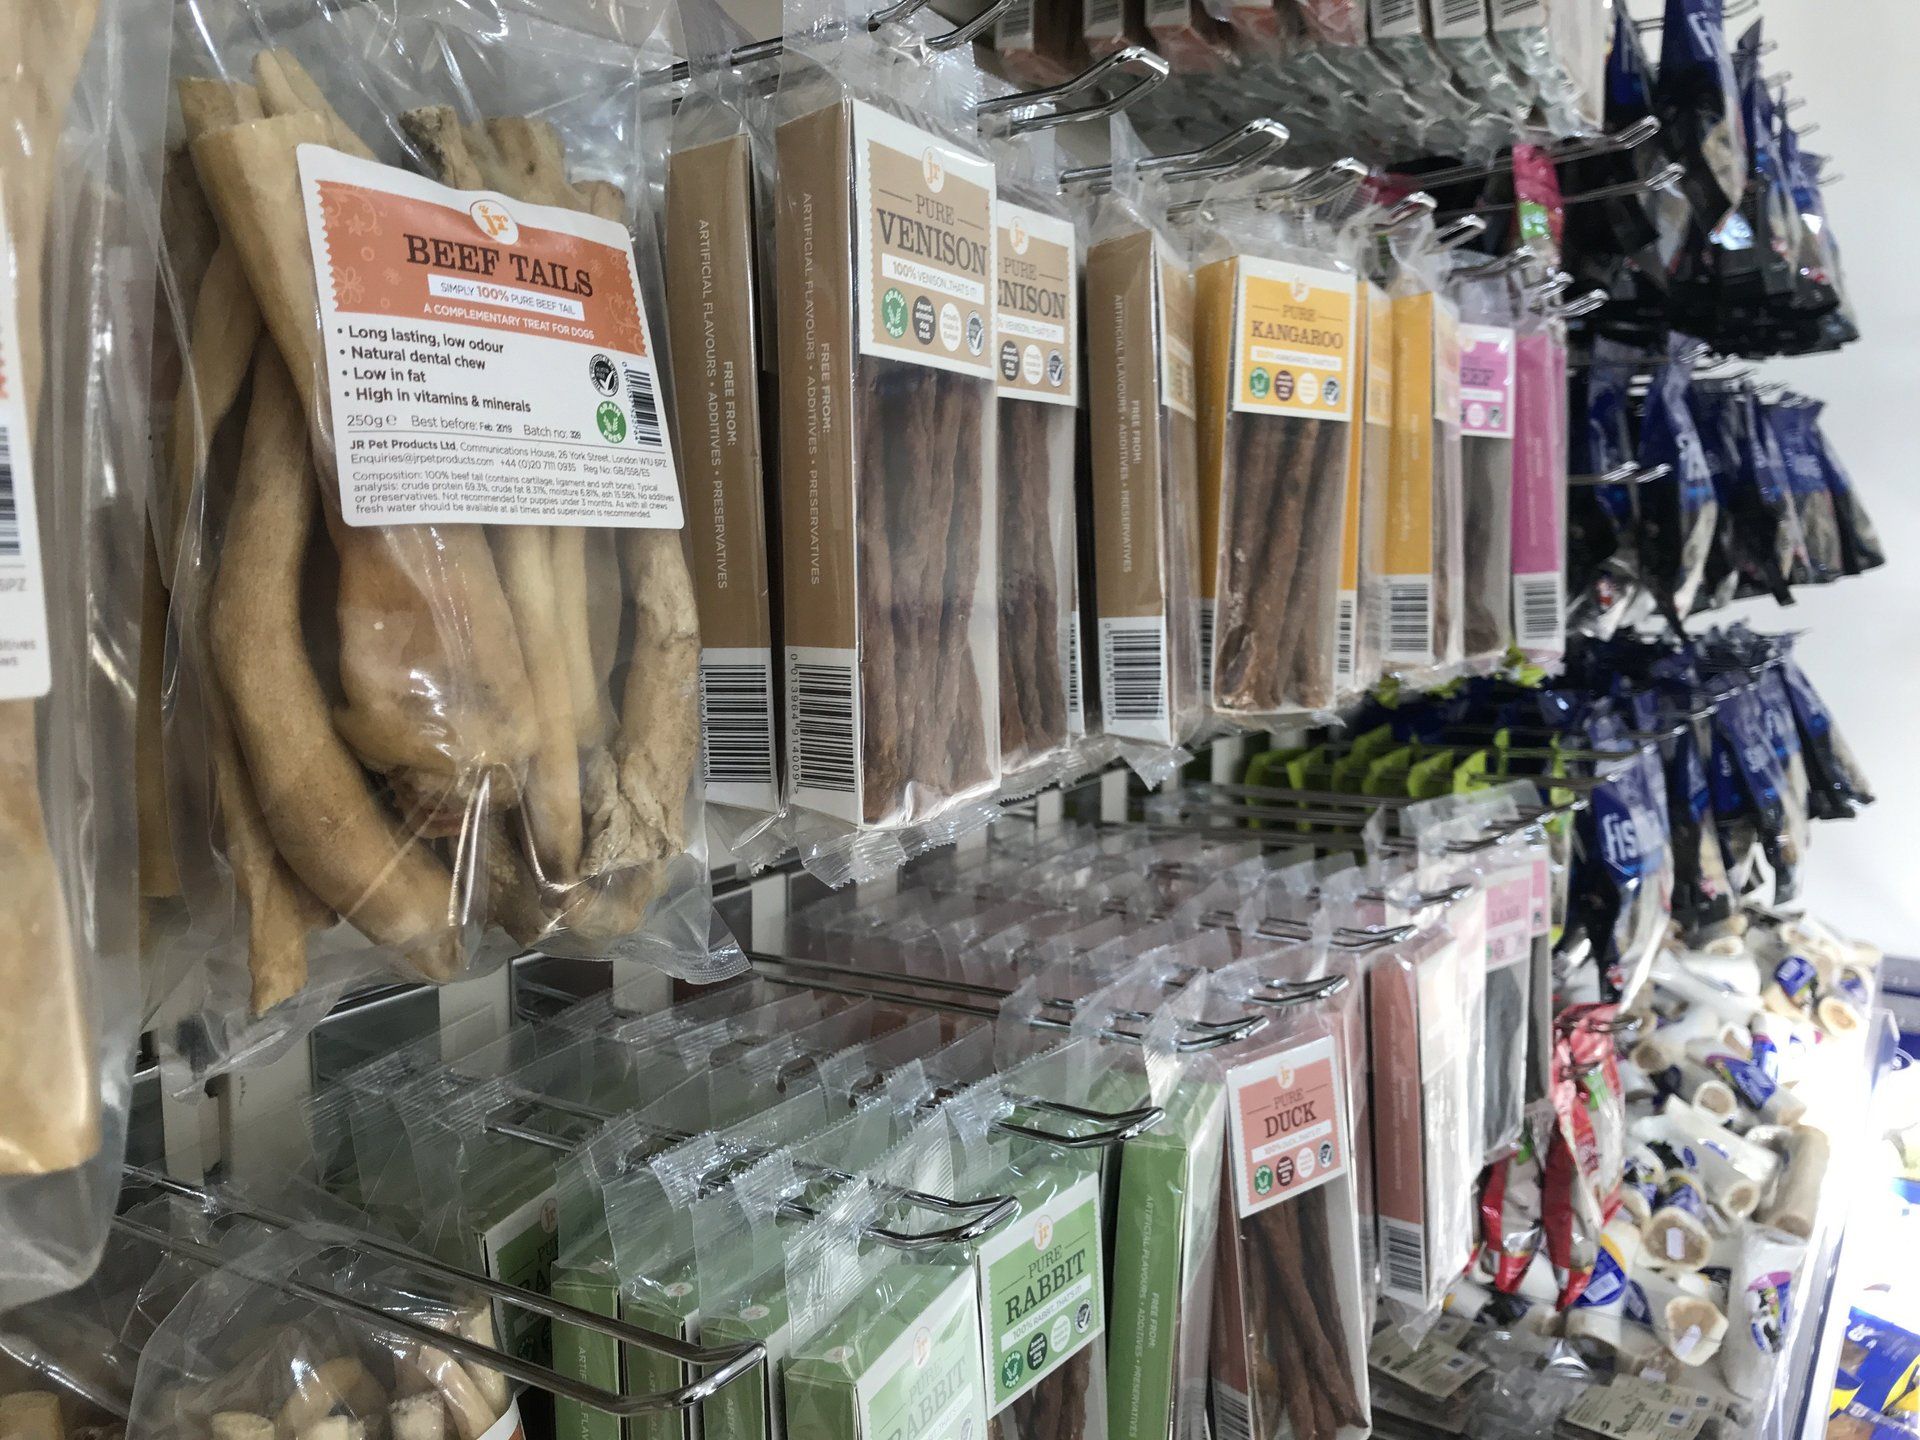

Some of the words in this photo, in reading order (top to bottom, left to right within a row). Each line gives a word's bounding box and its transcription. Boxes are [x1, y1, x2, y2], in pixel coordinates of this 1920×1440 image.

[916, 193, 954, 226] PURE
[802, 192, 813, 277] ARTIFICIAL
[877, 209, 987, 276] VENISON
[403, 233, 499, 276] BEEF
[509, 253, 593, 297] TAILS
[699, 219, 713, 299] ARTIFICIAL
[1004, 256, 1036, 280] PURE
[440, 282, 474, 296] SIMPLY
[476, 285, 509, 302] 100%
[511, 293, 534, 307] PURE
[536, 298, 557, 311] BEEF
[557, 303, 576, 315] TAIL
[998, 279, 1066, 319] NISON
[424, 303, 432, 314] A
[434, 304, 519, 326] COMPLEMENTARY
[522, 318, 550, 331] TREAT
[552, 323, 570, 334] FOR
[572, 326, 595, 340] DOGS
[804, 280, 815, 360] FLAVOURS
[1251, 320, 1343, 348] KANGAROO
[349, 325, 387, 342] Long
[392, 328, 440, 347] lasting,
[444, 333, 465, 347] low
[469, 339, 503, 353] odour
[351, 346, 405, 361] Natural
[410, 350, 450, 365] dental
[455, 356, 485, 369] chew
[703, 302, 717, 378] FLAVOURS
[354, 367, 386, 380] Low
[391, 368, 403, 381] in
[408, 369, 426, 383] fat
[723, 360, 734, 397] FREE
[820, 342, 830, 382] FREE
[356, 387, 393, 403] High
[397, 388, 410, 401] in
[414, 390, 468, 406] vitamins
[471, 395, 479, 407] &
[483, 397, 531, 412] minerals
[1116, 356, 1127, 413] FLAVOURS
[347, 415, 383, 427] 250g
[411, 415, 437, 428] Best
[440, 416, 477, 431] before:
[523, 425, 550, 437] Batch
[725, 401, 737, 446] FROM:
[806, 376, 817, 456] ADDITIVES
[821, 386, 831, 433] FROM:
[1130, 400, 1140, 427] FREE
[707, 391, 721, 467] ADDITIVES
[350, 440, 364, 450] JR
[369, 440, 387, 449] Pet
[392, 440, 437, 450] Products
[460, 443, 529, 456] Communications
[530, 449, 557, 460] House,
[559, 450, 568, 459] 26
[570, 450, 585, 461] York
[612, 455, 638, 465] London
[351, 454, 494, 466] Enquiries@jrpetproducts.com
[500, 459, 516, 468] +44
[518, 460, 541, 470] (0)20
[583, 465, 598, 475] Reg
[1118, 423, 1129, 481] ADDITIVES
[352, 471, 422, 482] Composition:
[425, 470, 449, 480] 100%
[451, 471, 469, 480] beef
[472, 471, 483, 480] tail
[485, 472, 519, 483] (contains
[556, 478, 585, 488] ligament
[354, 482, 398, 492] analysis:
[402, 482, 429, 490] crude
[432, 483, 463, 492] protein
[490, 484, 512, 493] crude
[549, 488, 579, 496] moisture
[355, 494, 366, 502] or
[370, 492, 438, 503] preservatives.
[460, 492, 514, 503] recommended
[517, 495, 528, 503] for
[530, 496, 558, 506] puppies
[560, 498, 580, 506] under
[356, 503, 383, 514] fresh
[387, 503, 416, 512] water
[419, 502, 450, 511] should
[453, 502, 463, 511] be
[466, 502, 498, 512] available
[500, 504, 508, 513] at
[520, 506, 540, 514] times
[542, 506, 556, 515] and
[557, 507, 595, 516] supervision
[713, 480, 728, 589] PRESERVATIVES
[808, 470, 820, 585] PRESERVATIVES
[1120, 490, 1132, 573] PRESERVATIVES
[1274, 1088, 1304, 1109] PURE
[1264, 1100, 1317, 1138] DUCK
[1027, 1244, 1063, 1279] PURE
[1140, 1248, 1150, 1299] FLAVOURS
[1005, 1249, 1087, 1325] RABBIT
[1150, 1292, 1159, 1317] FREE
[1013, 1321, 1034, 1340] 100%
[1135, 1307, 1145, 1358] ADDITIVES
[1129, 1365, 1141, 1438] PRESERVATIVES
